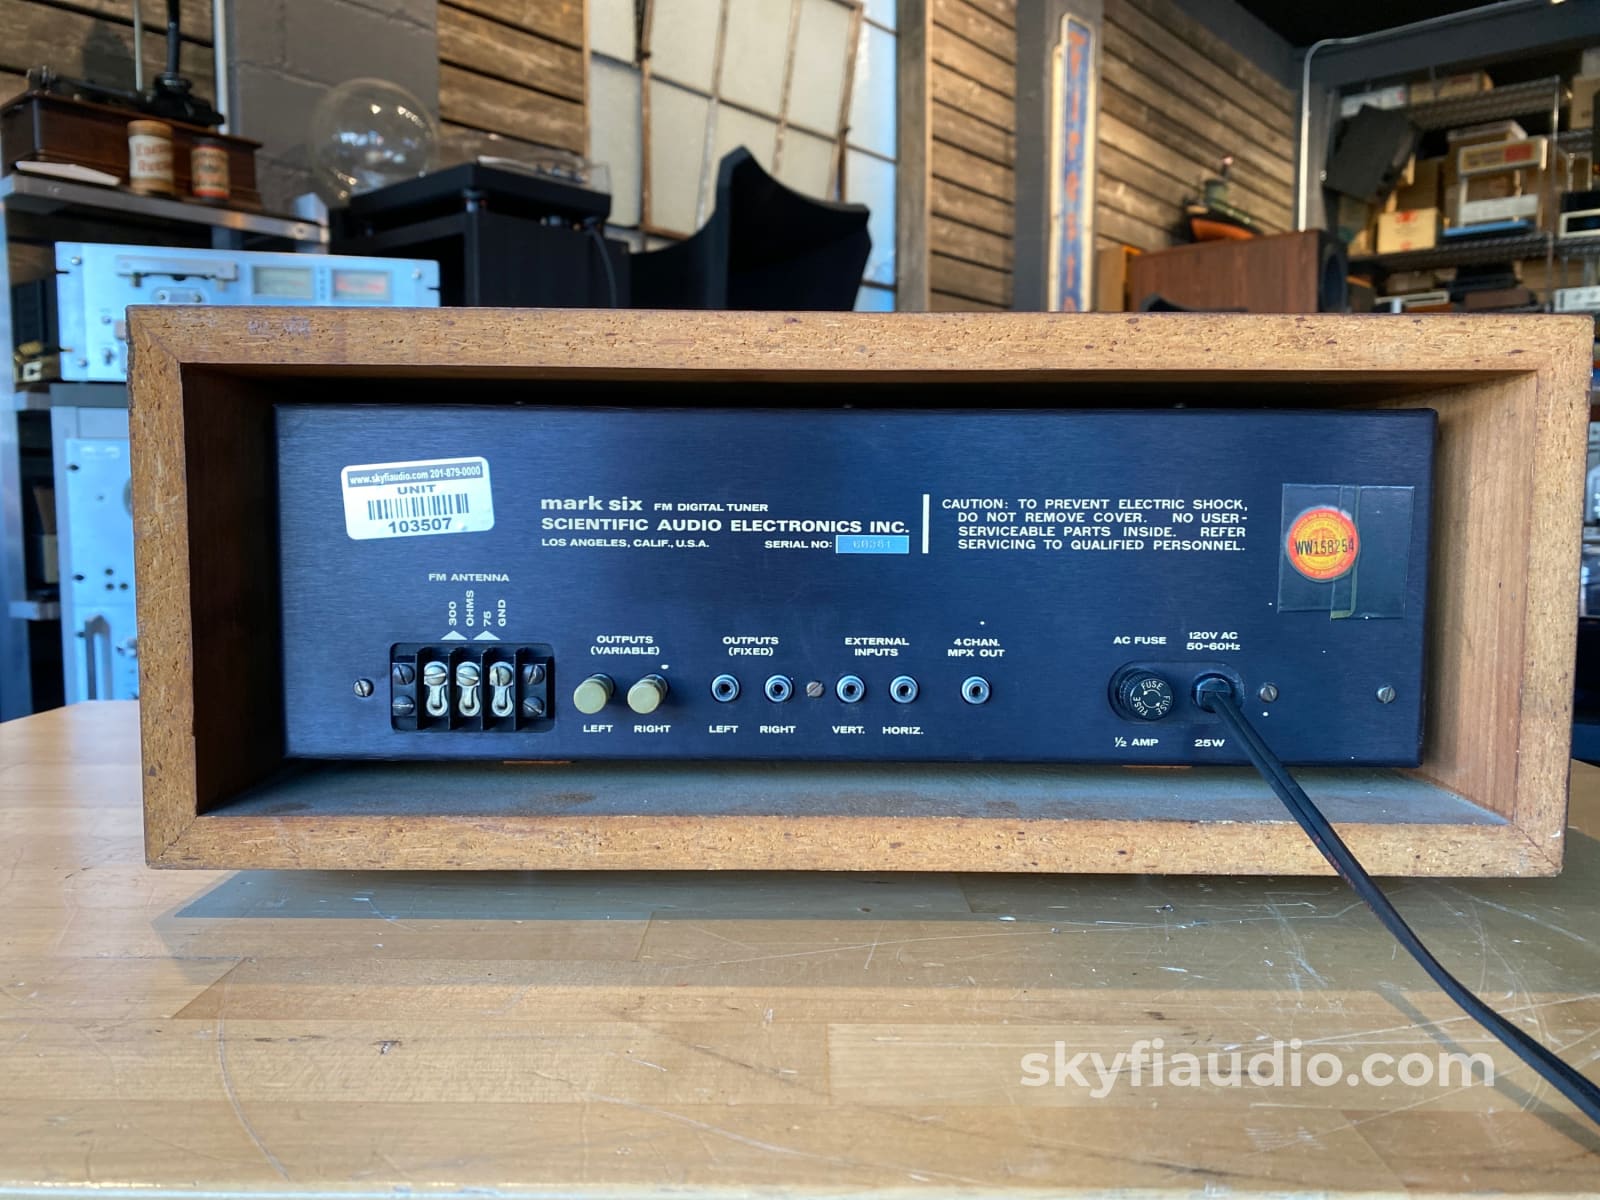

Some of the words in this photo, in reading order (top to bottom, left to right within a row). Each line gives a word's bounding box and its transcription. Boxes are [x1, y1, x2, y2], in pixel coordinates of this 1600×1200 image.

[350, 471, 429, 485] www.skyfiaudio.com
[429, 465, 481, 479] 201-879-0000
[397, 484, 436, 495] UNIT
[540, 495, 604, 511] mark
[608, 495, 643, 512] six
[653, 502, 673, 511] FM
[677, 502, 721, 512] DIGITAL
[721, 502, 770, 512] TUNER
[941, 498, 1009, 510] CAUTION:
[1017, 498, 1038, 510] TO
[1044, 498, 1111, 511] PREVENT
[1118, 498, 1185, 510] ELECTRIC
[1192, 498, 1248, 513] SHOCK,
[957, 511, 979, 523] DO
[986, 511, 1017, 523] NOT
[1024, 511, 1086, 523] REMOVE
[1095, 511, 1148, 524] COVER.
[1172, 512, 1194, 524] NO
[1201, 512, 1249, 524] USER-
[388, 517, 452, 534] 103507
[541, 517, 649, 531] SCIENTIFIC
[656, 518, 722, 532] AUDIO
[730, 519, 864, 534] ELECTRONICS
[866, 520, 911, 534] INC.
[958, 525, 1056, 537] SERVICEABLE
[1063, 526, 1112, 537] PARTS
[1123, 526, 1177, 538] INSIDE.
[1200, 526, 1246, 538] REFER
[541, 538, 567, 547] LOS
[569, 538, 631, 548] ANGELES,
[632, 538, 674, 549] CALIF.,
[675, 539, 710, 548] U.S.A.
[764, 540, 809, 549] SERIAL
[810, 540, 833, 549] NO:
[957, 538, 1036, 550] SERVICING
[1042, 539, 1063, 550] TO
[1070, 539, 1145, 551] QUALIFIED
[1153, 539, 1246, 551] PERSONNEL.
[428, 573, 447, 582] FM
[450, 573, 510, 582] ANTENNA
[448, 600, 457, 626] 300
[465, 589, 475, 627] OHMS
[497, 599, 507, 627] GND
[483, 610, 492, 627] 75
[596, 634, 654, 645] OUTPUTS
[722, 636, 779, 645] OUTPUTS
[1113, 635, 1131, 645] AC
[1134, 636, 1167, 645] FUSE
[1188, 631, 1218, 640] 120V
[1220, 631, 1238, 640] AC
[844, 637, 910, 646] EXTERNAL
[953, 638, 962, 647] 4
[962, 638, 1001, 647] CHAN.
[1186, 642, 1241, 651] 50-60Hz
[590, 644, 661, 657] (VARIABLE)
[728, 646, 774, 657] (FIXED)
[854, 648, 899, 657] INPUTS
[947, 648, 975, 657] MPX
[979, 648, 1006, 658] OUT
[1140, 680, 1164, 691] FUSE
[1132, 696, 1149, 716] FUSE
[1155, 695, 1171, 716] FUSE
[582, 724, 614, 733] LEFT
[633, 724, 672, 733] RIGHT
[708, 724, 739, 734] LEFT
[759, 725, 797, 734] RIGHT
[831, 725, 866, 735] VERT.
[882, 726, 924, 735] HORIZ.
[1131, 738, 1159, 747] AMP
[1194, 738, 1226, 748] 25W
